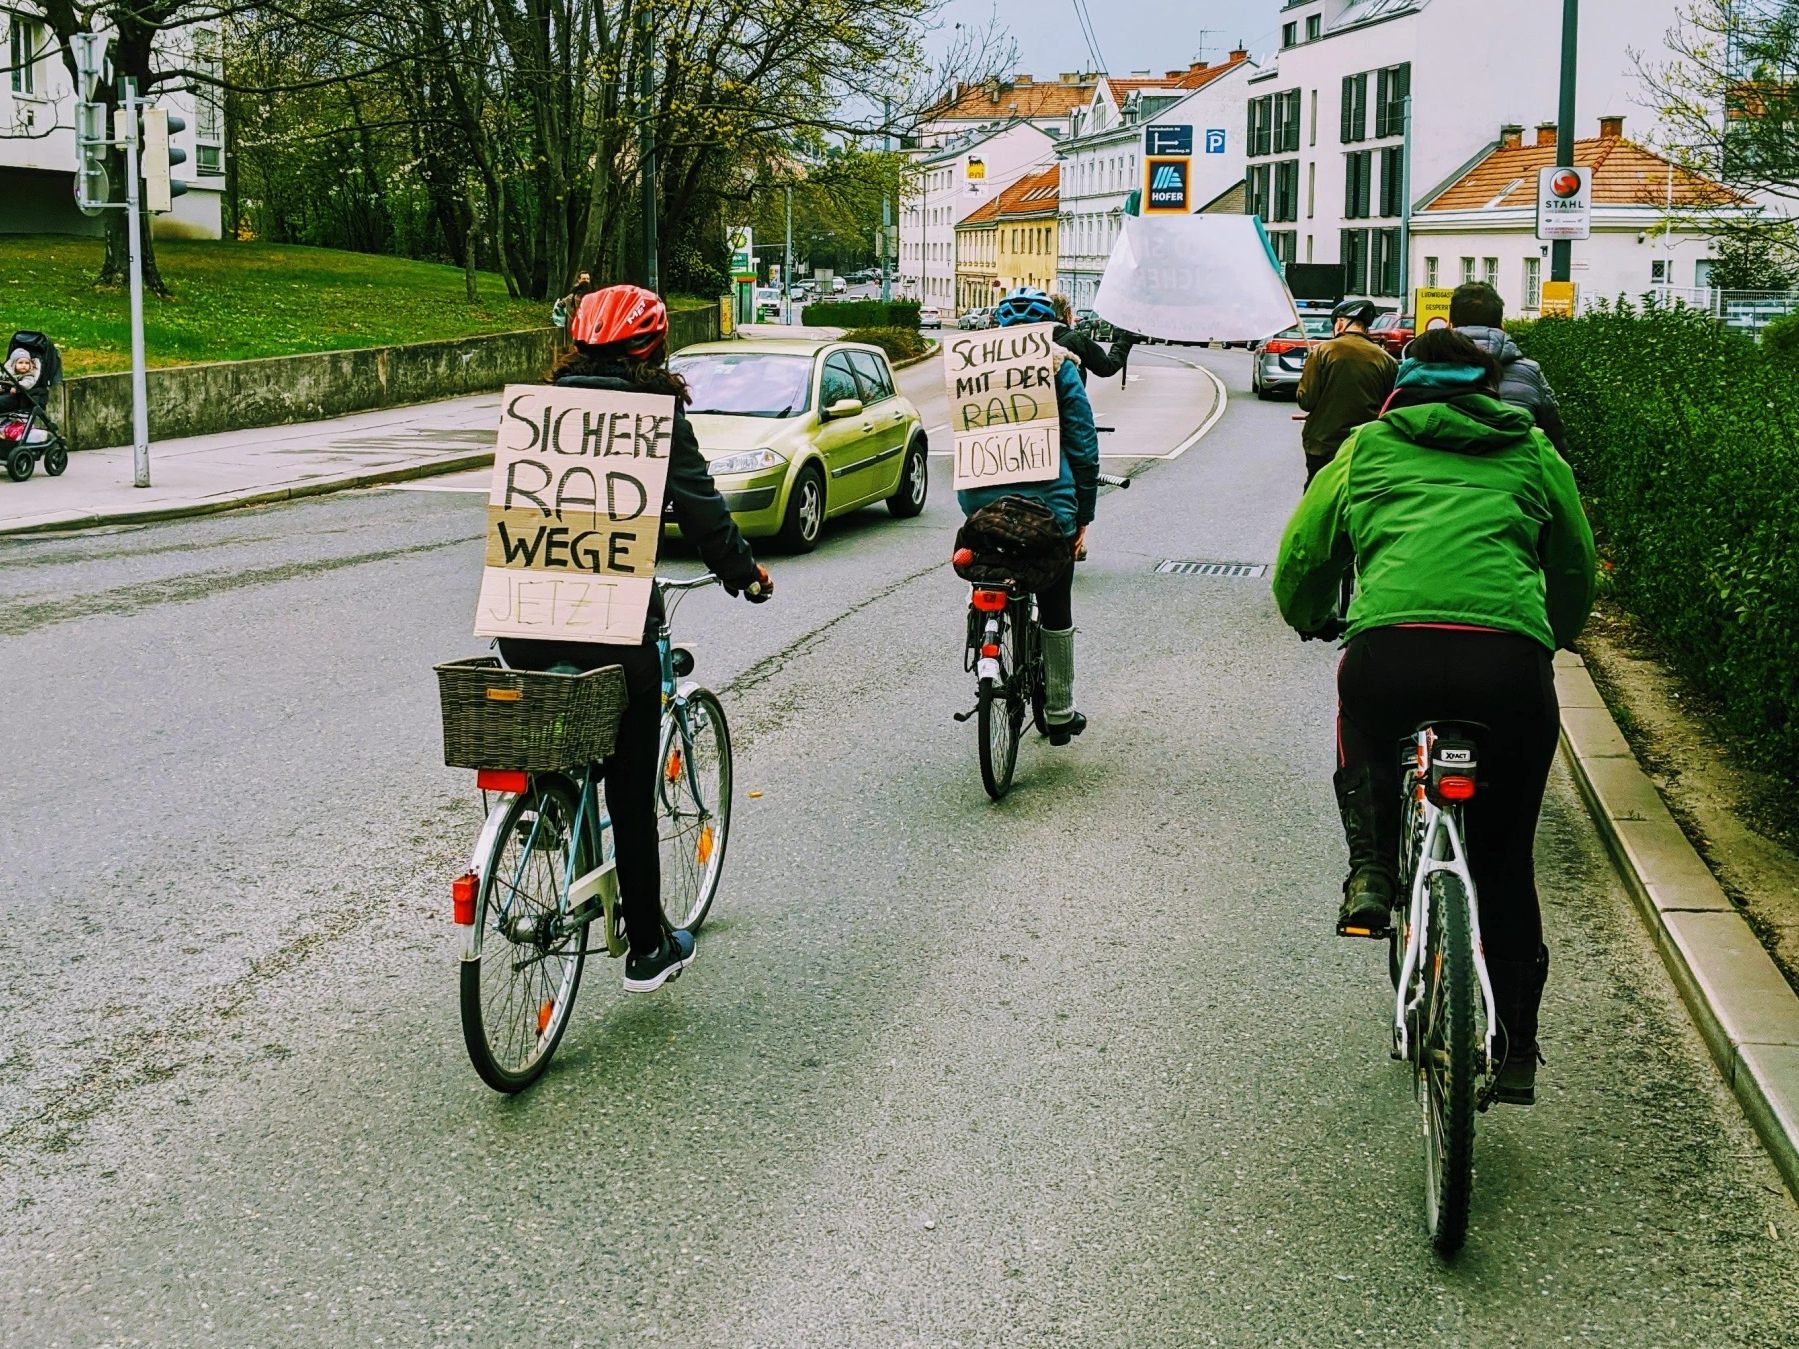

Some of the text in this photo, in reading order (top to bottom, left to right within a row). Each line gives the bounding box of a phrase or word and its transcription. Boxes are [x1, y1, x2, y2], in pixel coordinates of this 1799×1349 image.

[1209, 135, 1223, 152] P
[1152, 192, 1184, 201] HOFER
[1545, 200, 1584, 208] STAHL
[626, 300, 646, 325] MET
[952, 332, 1050, 371] SCHLUSS
[957, 365, 1050, 399] MIT DER
[507, 394, 672, 459] SICHERE
[962, 393, 1038, 432] RAD
[505, 459, 647, 530] RAD
[497, 521, 637, 574] WEGE
[489, 577, 618, 630] JETZT
